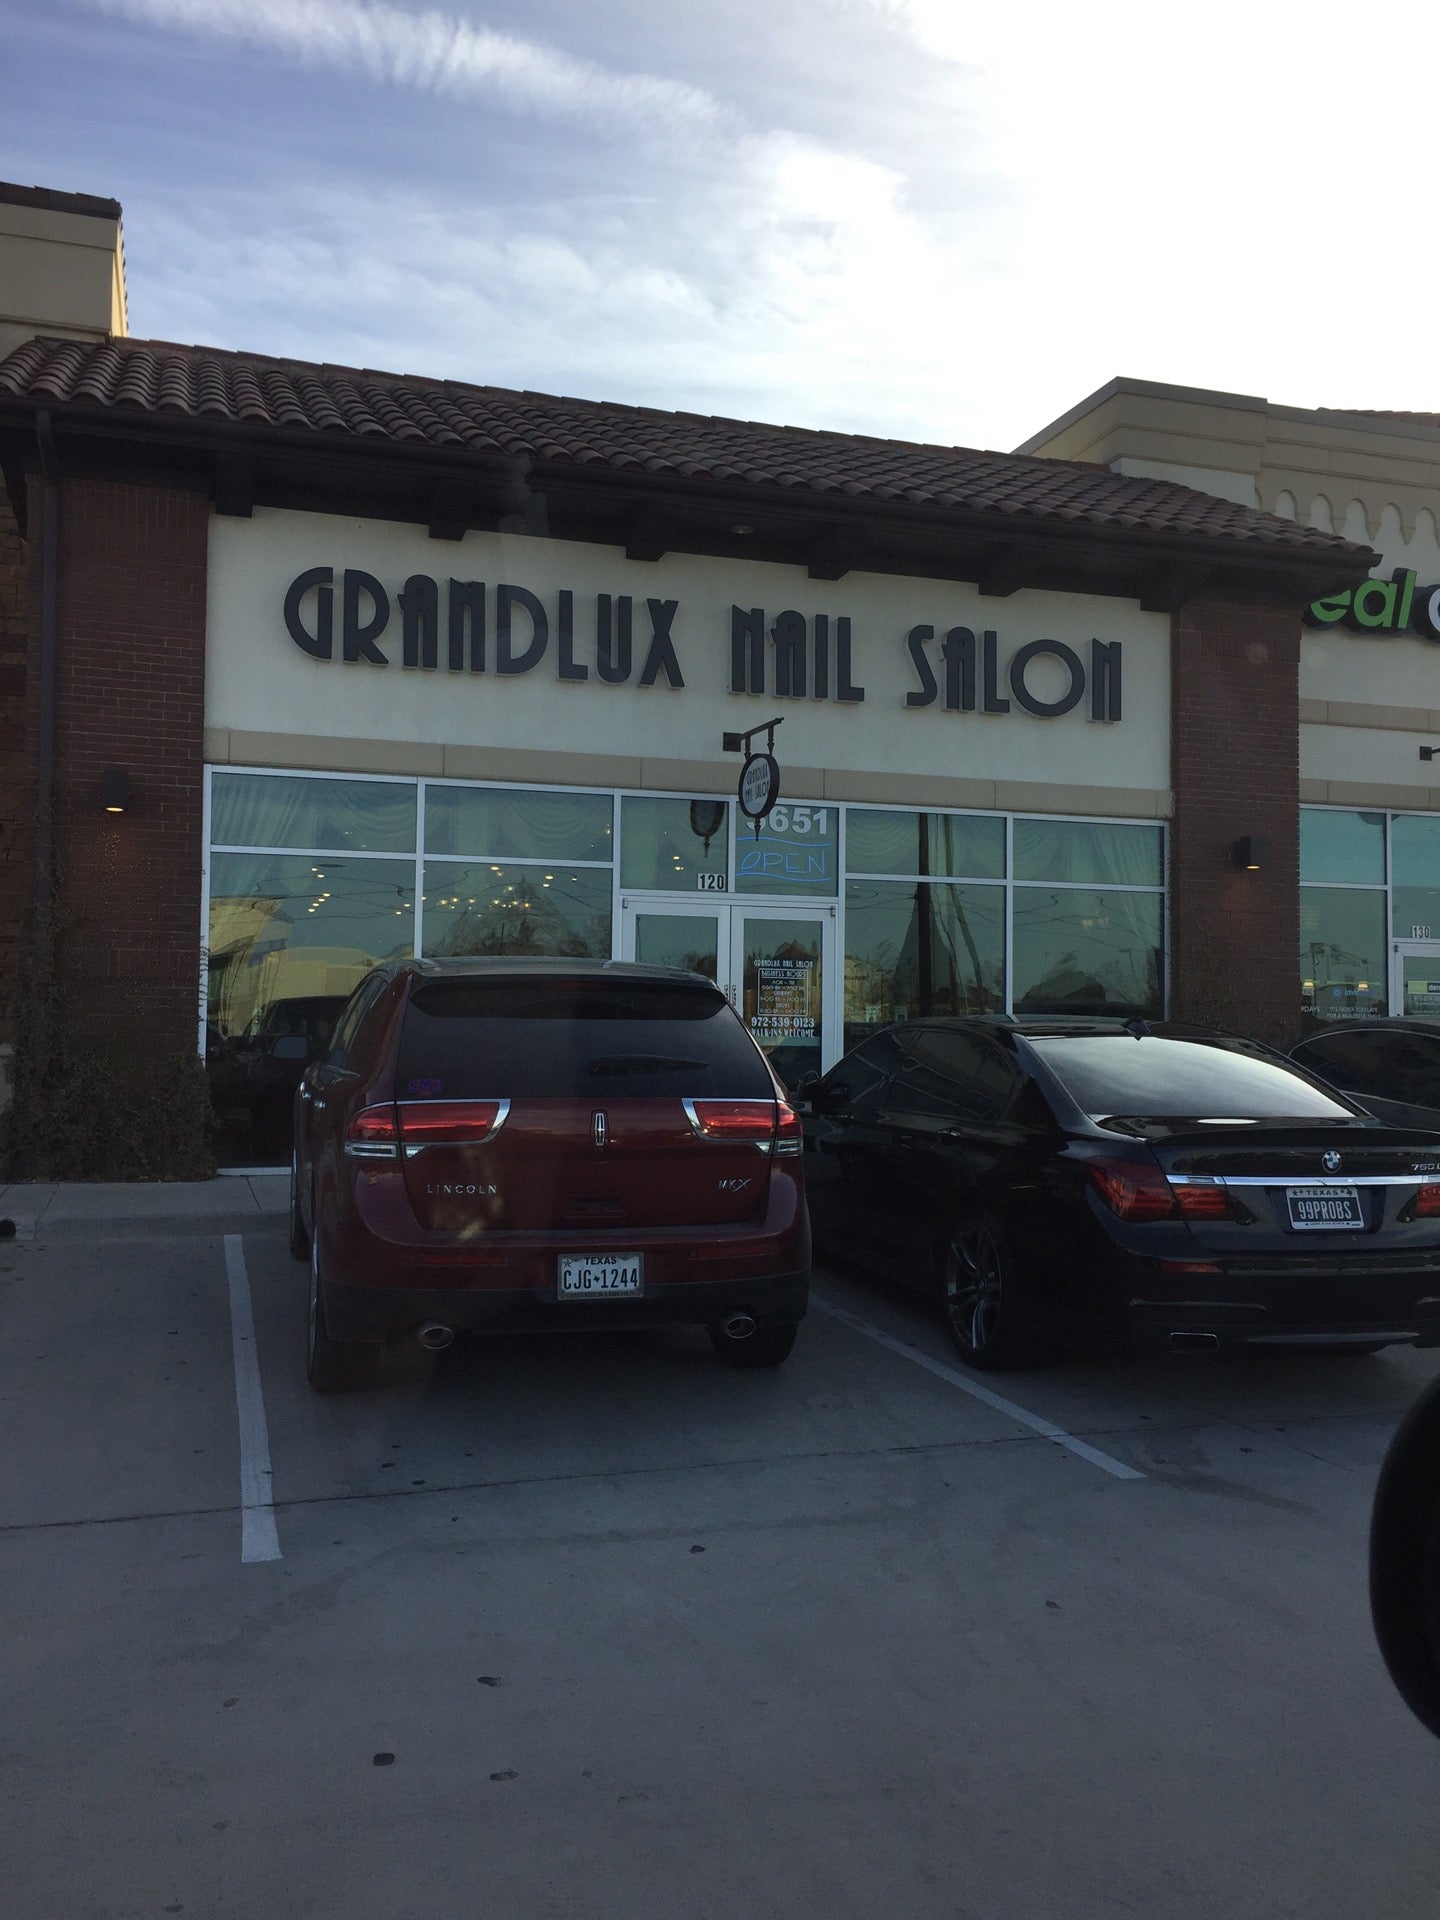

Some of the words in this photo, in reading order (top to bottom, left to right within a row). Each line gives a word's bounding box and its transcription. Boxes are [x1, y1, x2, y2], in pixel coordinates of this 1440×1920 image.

[283, 566, 686, 690] GRANDLUX
[728, 604, 865, 703] NAIL
[903, 624, 1122, 723] SALON
[740, 850, 825, 874] OPEN
[699, 874, 725, 890] 120
[1412, 926, 1430, 938] 130
[751, 1016, 815, 1028] 972-539-0123
[751, 1028, 782, 1037] WALK-INS
[783, 1028, 815, 1038] WELCOME
[427, 1184, 497, 1194] LINCOLN
[718, 1178, 752, 1191] MKX
[1298, 1200, 1352, 1220] 99PROBS
[584, 1256, 617, 1265] TEXAS
